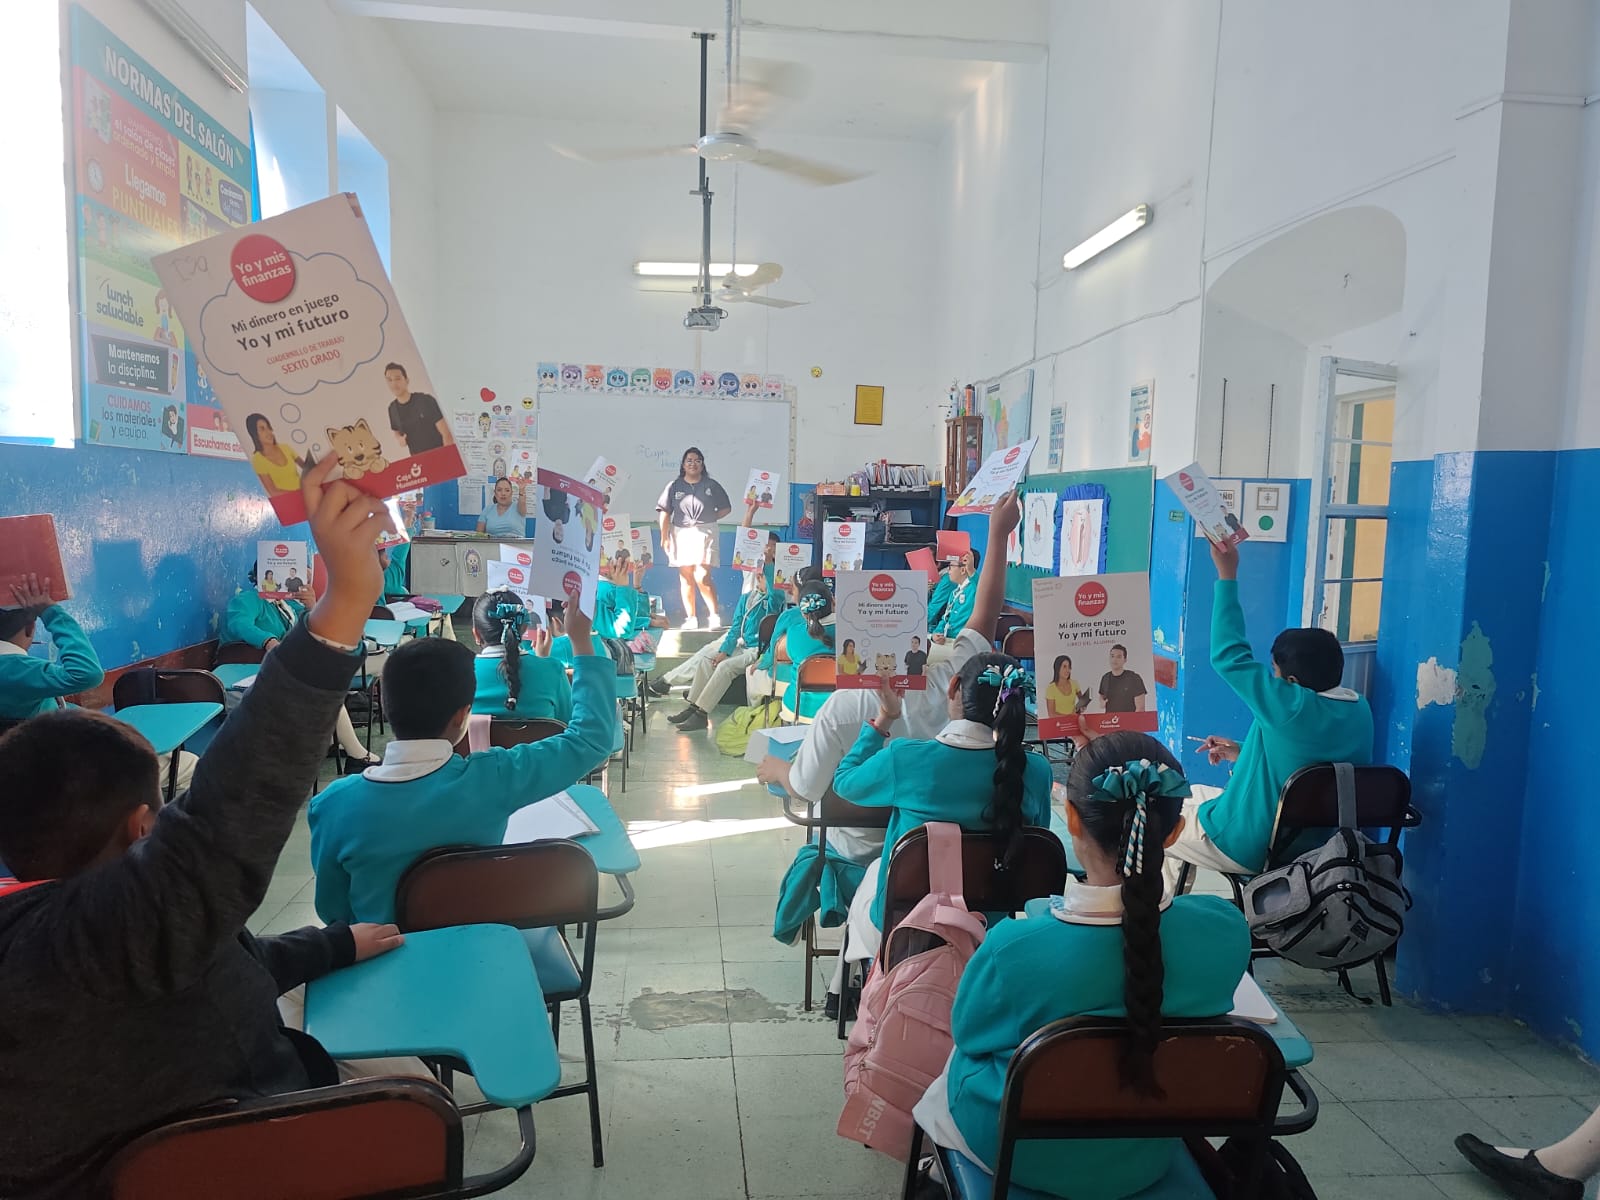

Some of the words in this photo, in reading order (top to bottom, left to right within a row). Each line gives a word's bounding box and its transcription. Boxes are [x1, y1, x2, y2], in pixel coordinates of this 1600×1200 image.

[105, 46, 171, 121] NORMAS
[174, 103, 196, 140] DEL
[198, 122, 235, 169] SALÓN
[125, 163, 167, 208] Llegamos
[235, 261, 253, 276] Yo
[256, 257, 265, 272] y
[266, 250, 287, 267] mis
[240, 263, 292, 288] finanzas
[96, 301, 144, 328] saludable
[231, 318, 248, 334] Mi
[248, 309, 287, 331] dinero
[288, 303, 304, 318] en
[303, 292, 341, 316] juego
[237, 335, 259, 352] Yo
[261, 332, 273, 349] y
[275, 322, 297, 341] mi
[297, 307, 350, 334] futuro
[108, 343, 161, 366] Mantenemos
[281, 358, 310, 375] SEXTO
[310, 348, 341, 366] GRADO
[107, 361, 118, 375] la
[118, 361, 157, 381] disciplina.
[107, 394, 152, 413] CUIDAMOS
[102, 408, 114, 423] los
[116, 411, 157, 428] materiales
[111, 426, 118, 440] y
[193, 434, 232, 453] Escuchamos
[1078, 592, 1087, 600] Yo
[1093, 591, 1105, 599] mis
[1058, 632, 1070, 640] Yo
[1072, 633, 1078, 641] y
[1080, 630, 1093, 638] mi
[1094, 628, 1127, 637] futuro
[1069, 621, 1092, 629] dinero
[1103, 619, 1125, 628] juego
